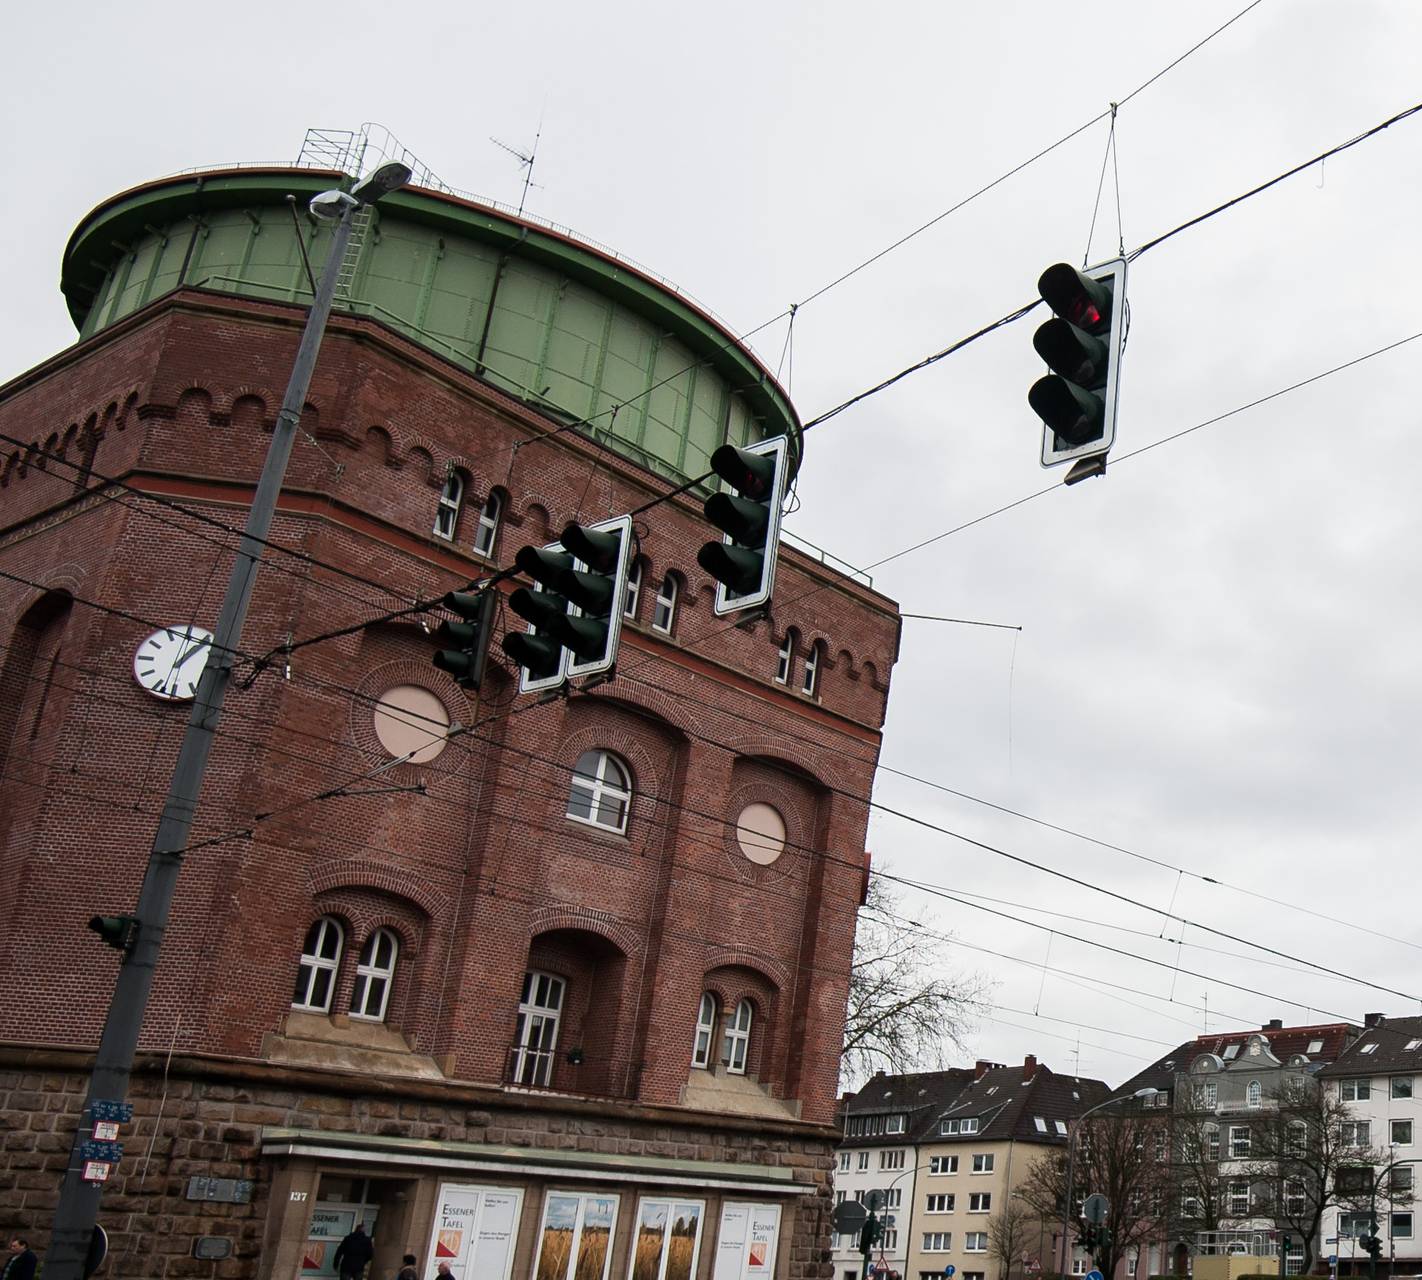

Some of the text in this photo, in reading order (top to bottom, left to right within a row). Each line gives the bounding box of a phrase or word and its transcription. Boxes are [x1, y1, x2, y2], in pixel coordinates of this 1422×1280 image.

[290, 1191, 308, 1202] 137
[442, 1203, 475, 1216] ESSENER
[311, 1214, 340, 1223] SSENER
[442, 1216, 464, 1229] TAFEL
